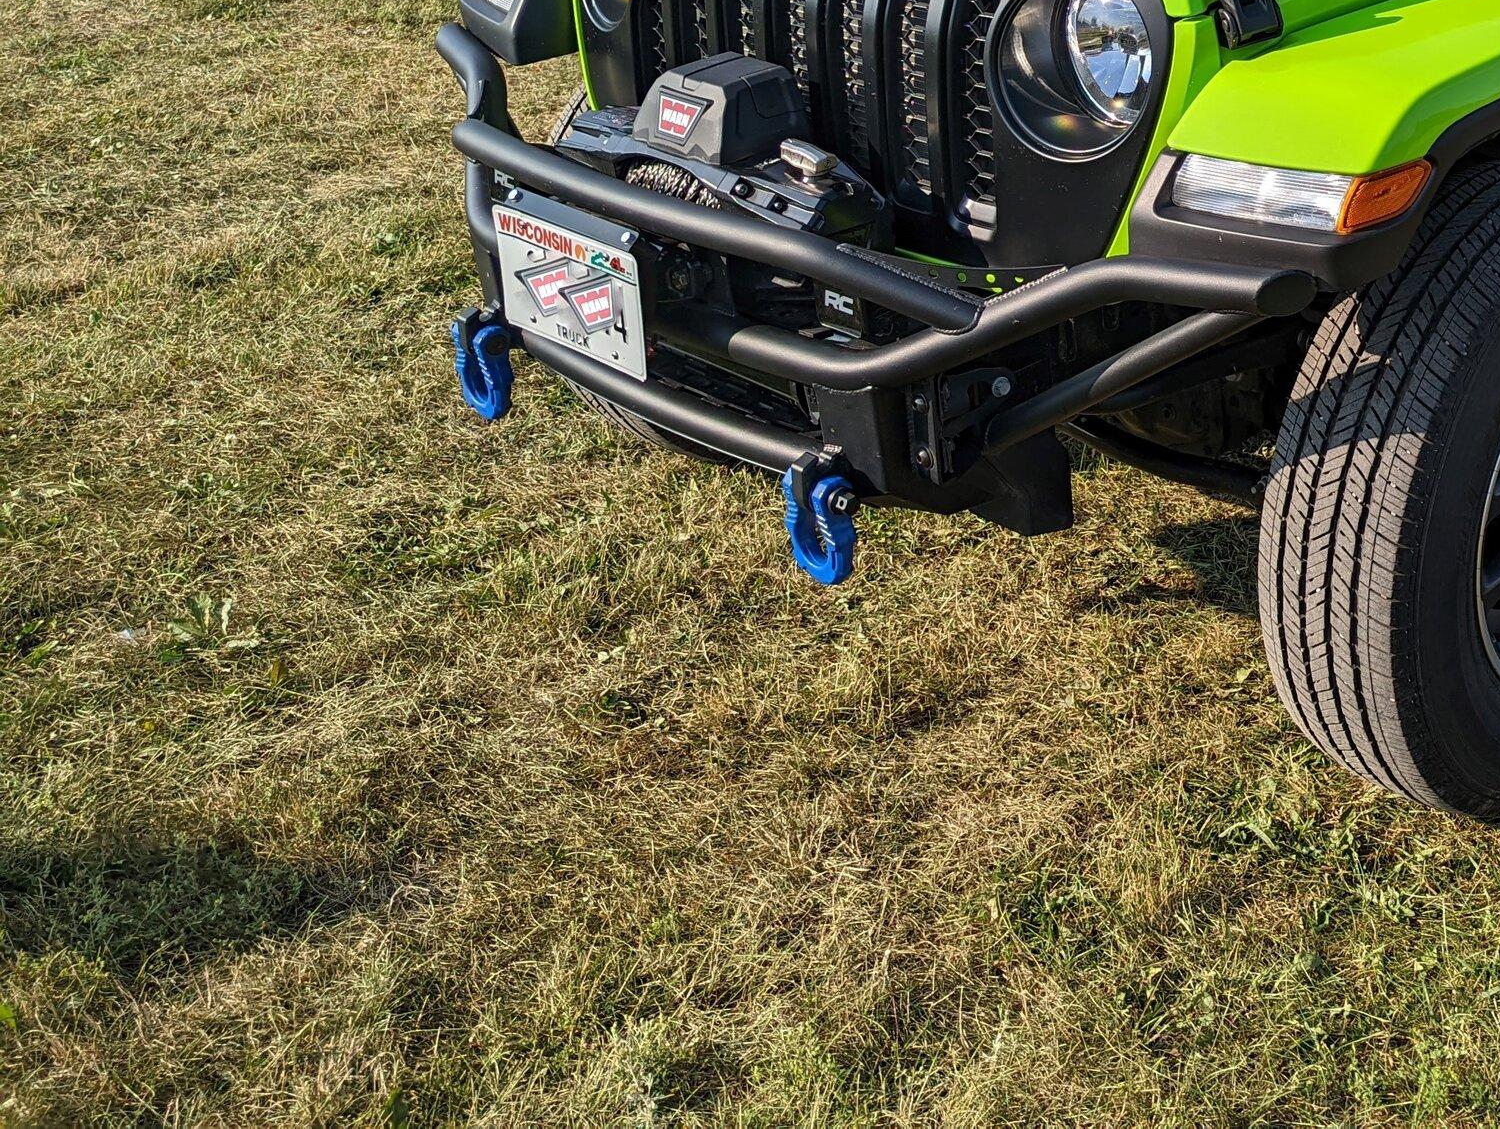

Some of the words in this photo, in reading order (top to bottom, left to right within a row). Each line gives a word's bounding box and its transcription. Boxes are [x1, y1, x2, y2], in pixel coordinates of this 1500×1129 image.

[662, 107, 690, 127] WARN
[494, 169, 515, 189] RC
[498, 212, 573, 257] WISCONSIN
[824, 288, 854, 316] RC
[555, 323, 590, 349] TRUCK
